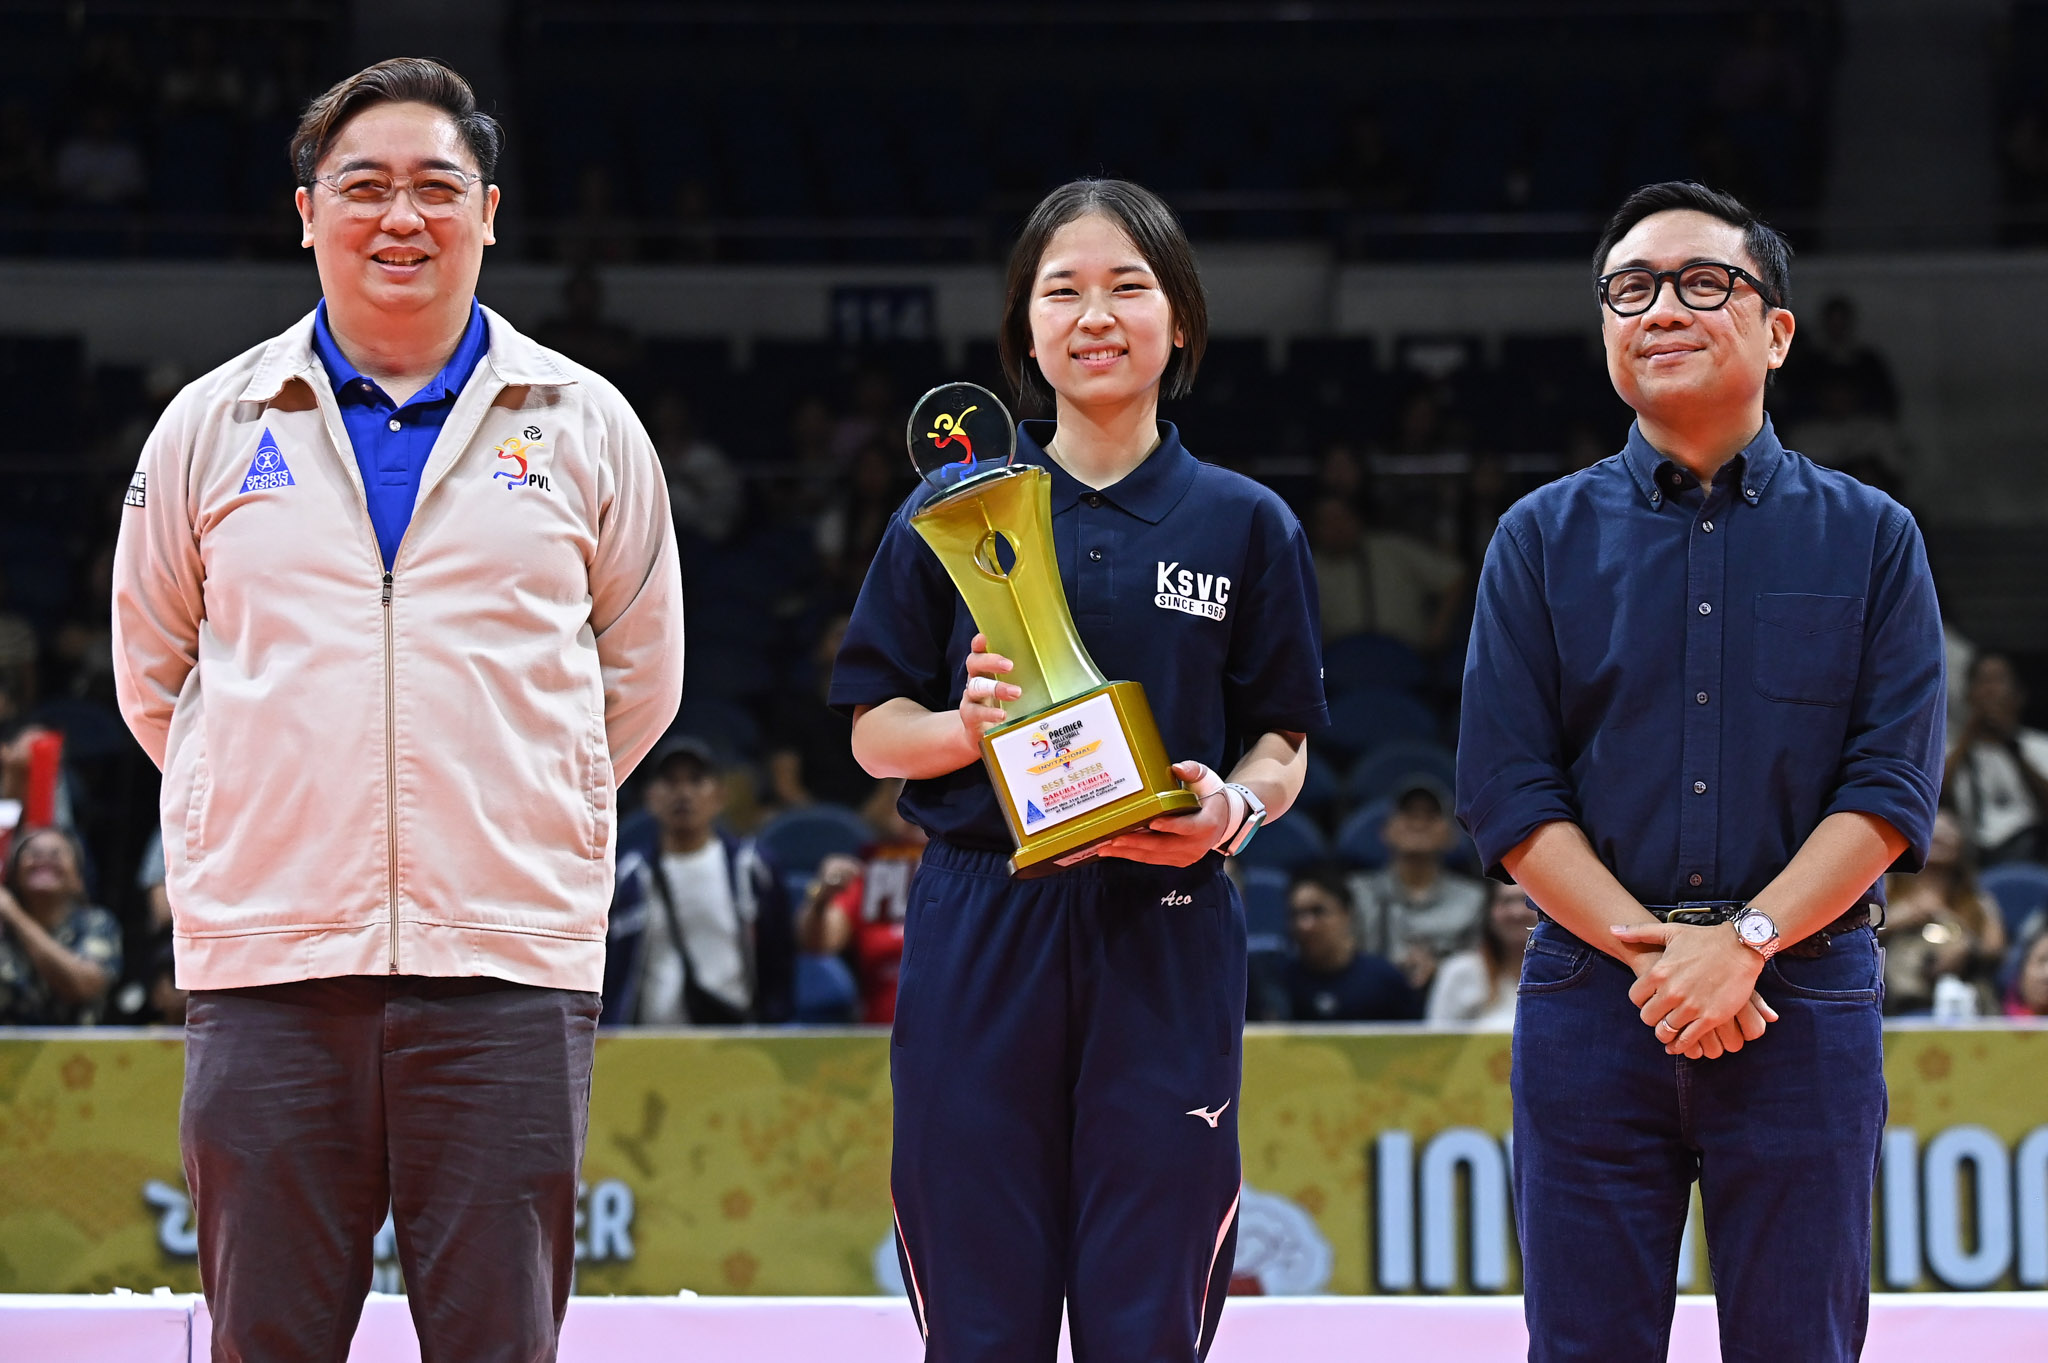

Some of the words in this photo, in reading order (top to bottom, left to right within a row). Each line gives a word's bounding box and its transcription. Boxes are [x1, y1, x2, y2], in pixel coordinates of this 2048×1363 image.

[246, 470, 289, 484] SPORTS
[247, 478, 288, 491] VISION
[529, 474, 551, 492] PVL
[1159, 595, 1195, 612] SINCE
[1201, 603, 1224, 619] 1966
[1048, 719, 1083, 739] PREMIER
[1051, 729, 1079, 745] VOLLEYBALL
[1053, 739, 1071, 750] LEAGUE
[1038, 747, 1090, 771] INVITATIONAL
[1041, 777, 1065, 792] BEST
[1067, 761, 1103, 781] SETTER
[1042, 785, 1075, 802] SAKURA
[1077, 771, 1108, 788] FURUTA
[1161, 890, 1192, 906] Aco
